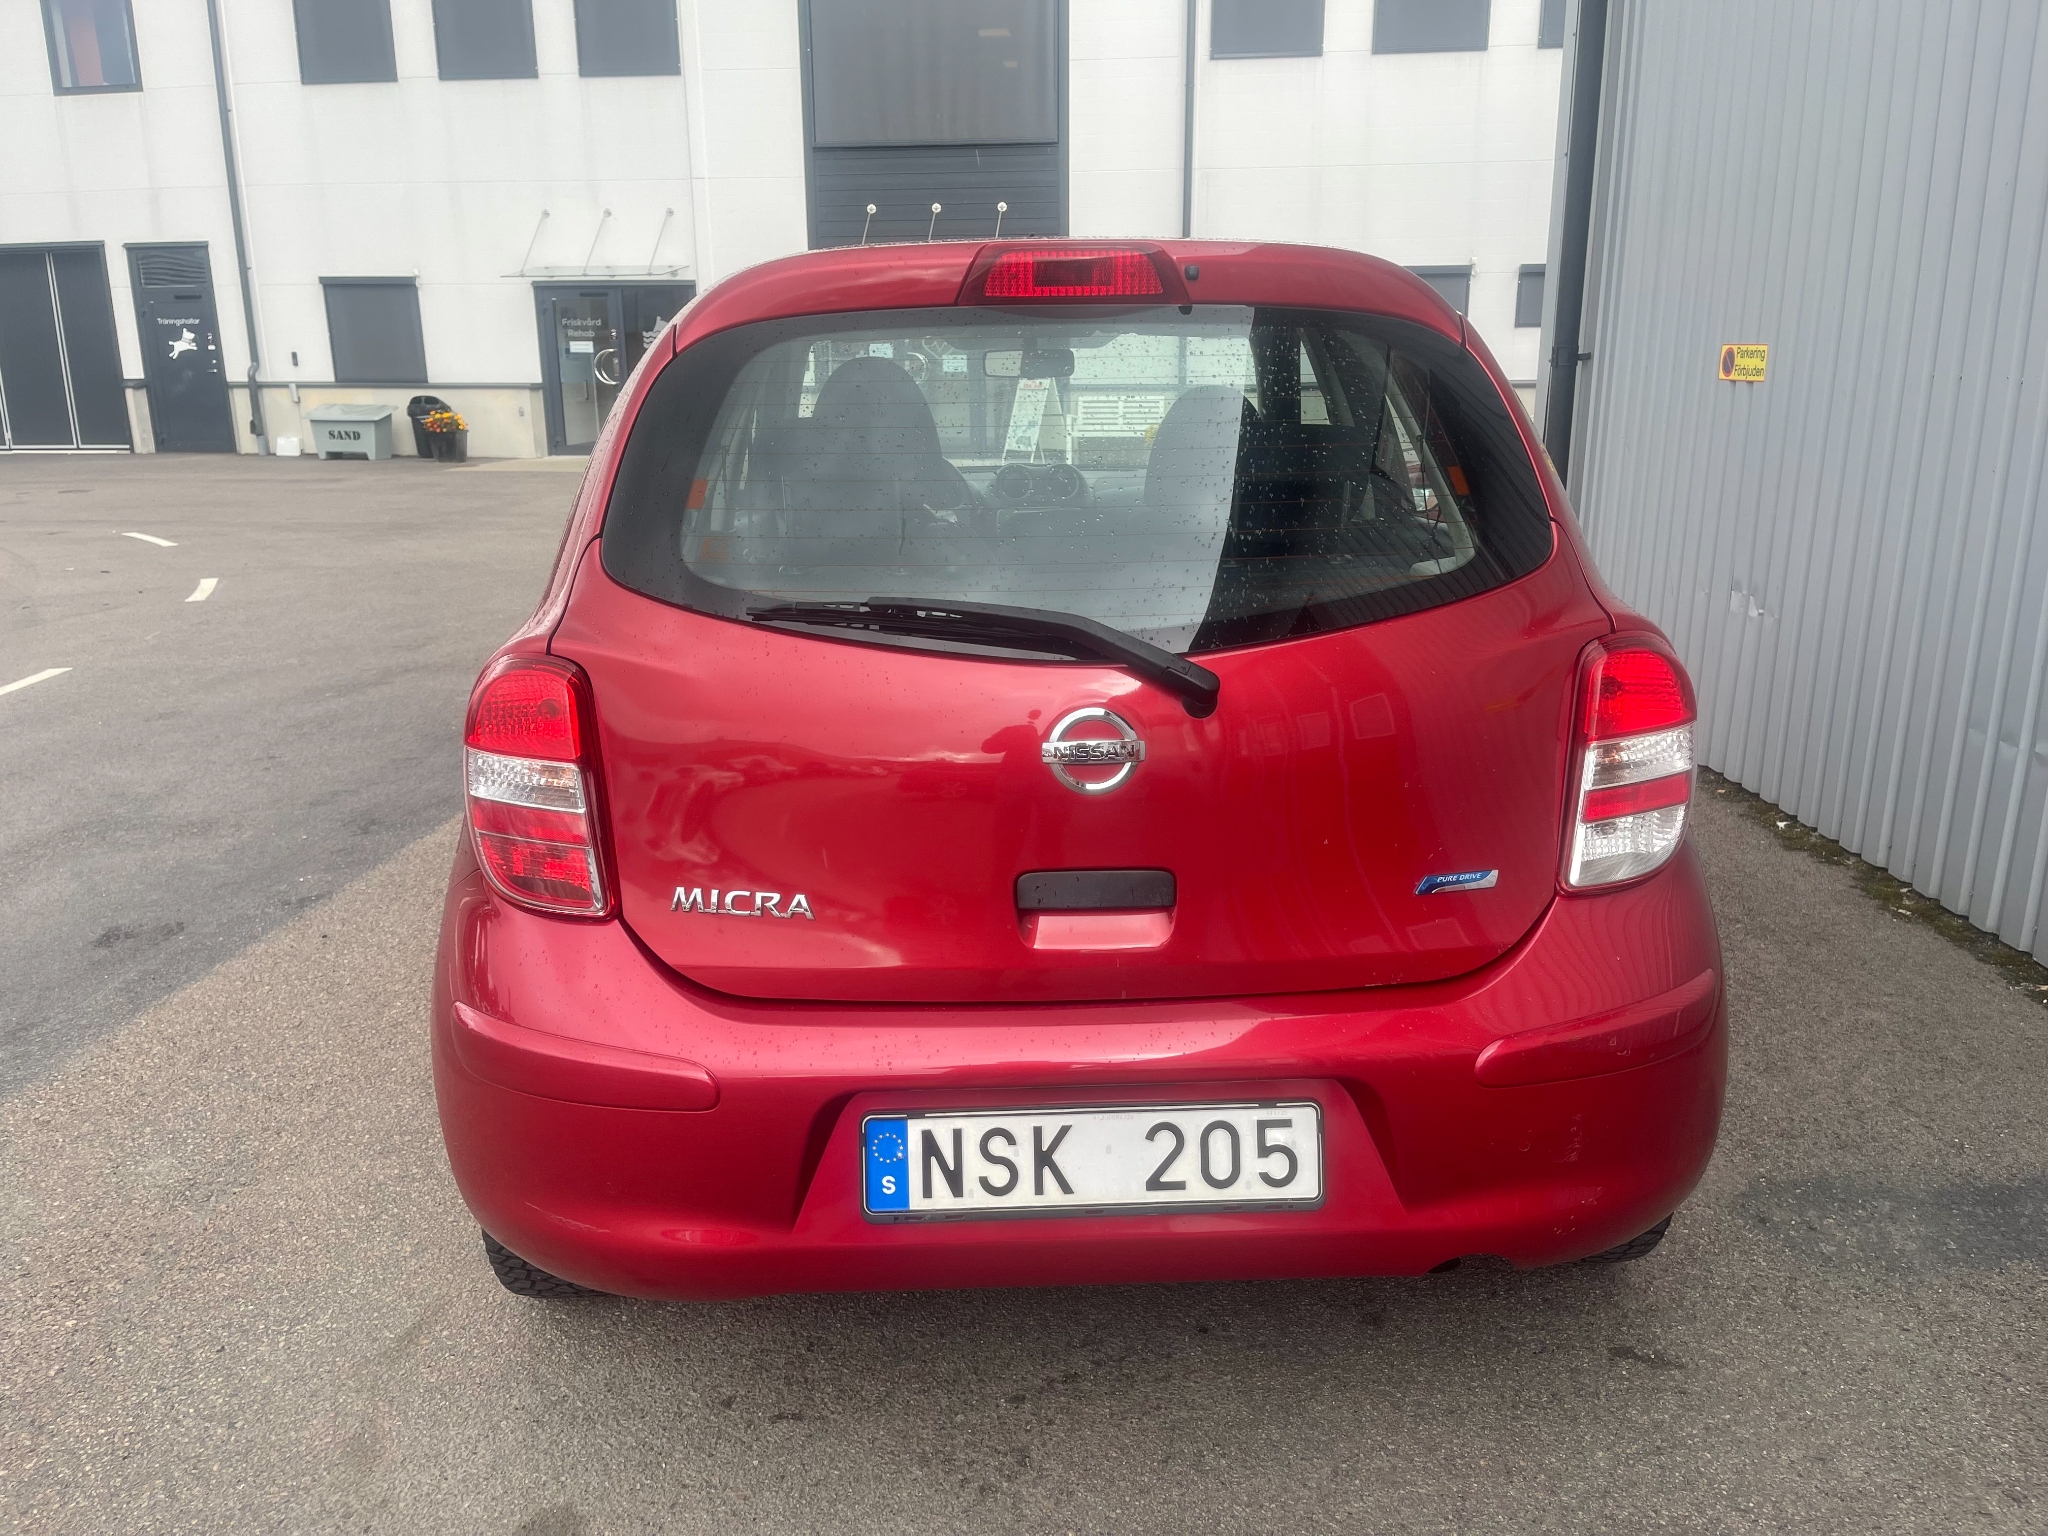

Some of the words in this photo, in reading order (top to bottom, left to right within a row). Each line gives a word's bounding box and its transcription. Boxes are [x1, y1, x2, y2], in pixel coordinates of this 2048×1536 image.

[561, 317, 601, 326] Friskvård
[567, 329, 595, 337] Rehab
[1736, 347, 1766, 361] Parkering
[328, 430, 361, 441] SAND
[1053, 744, 1140, 761] NISSAN
[1460, 872, 1483, 880] DRIVE
[671, 886, 815, 920] MICRA
[921, 1122, 1075, 1199] NSK
[1145, 1118, 1298, 1192] 205
[881, 1175, 897, 1195] S
